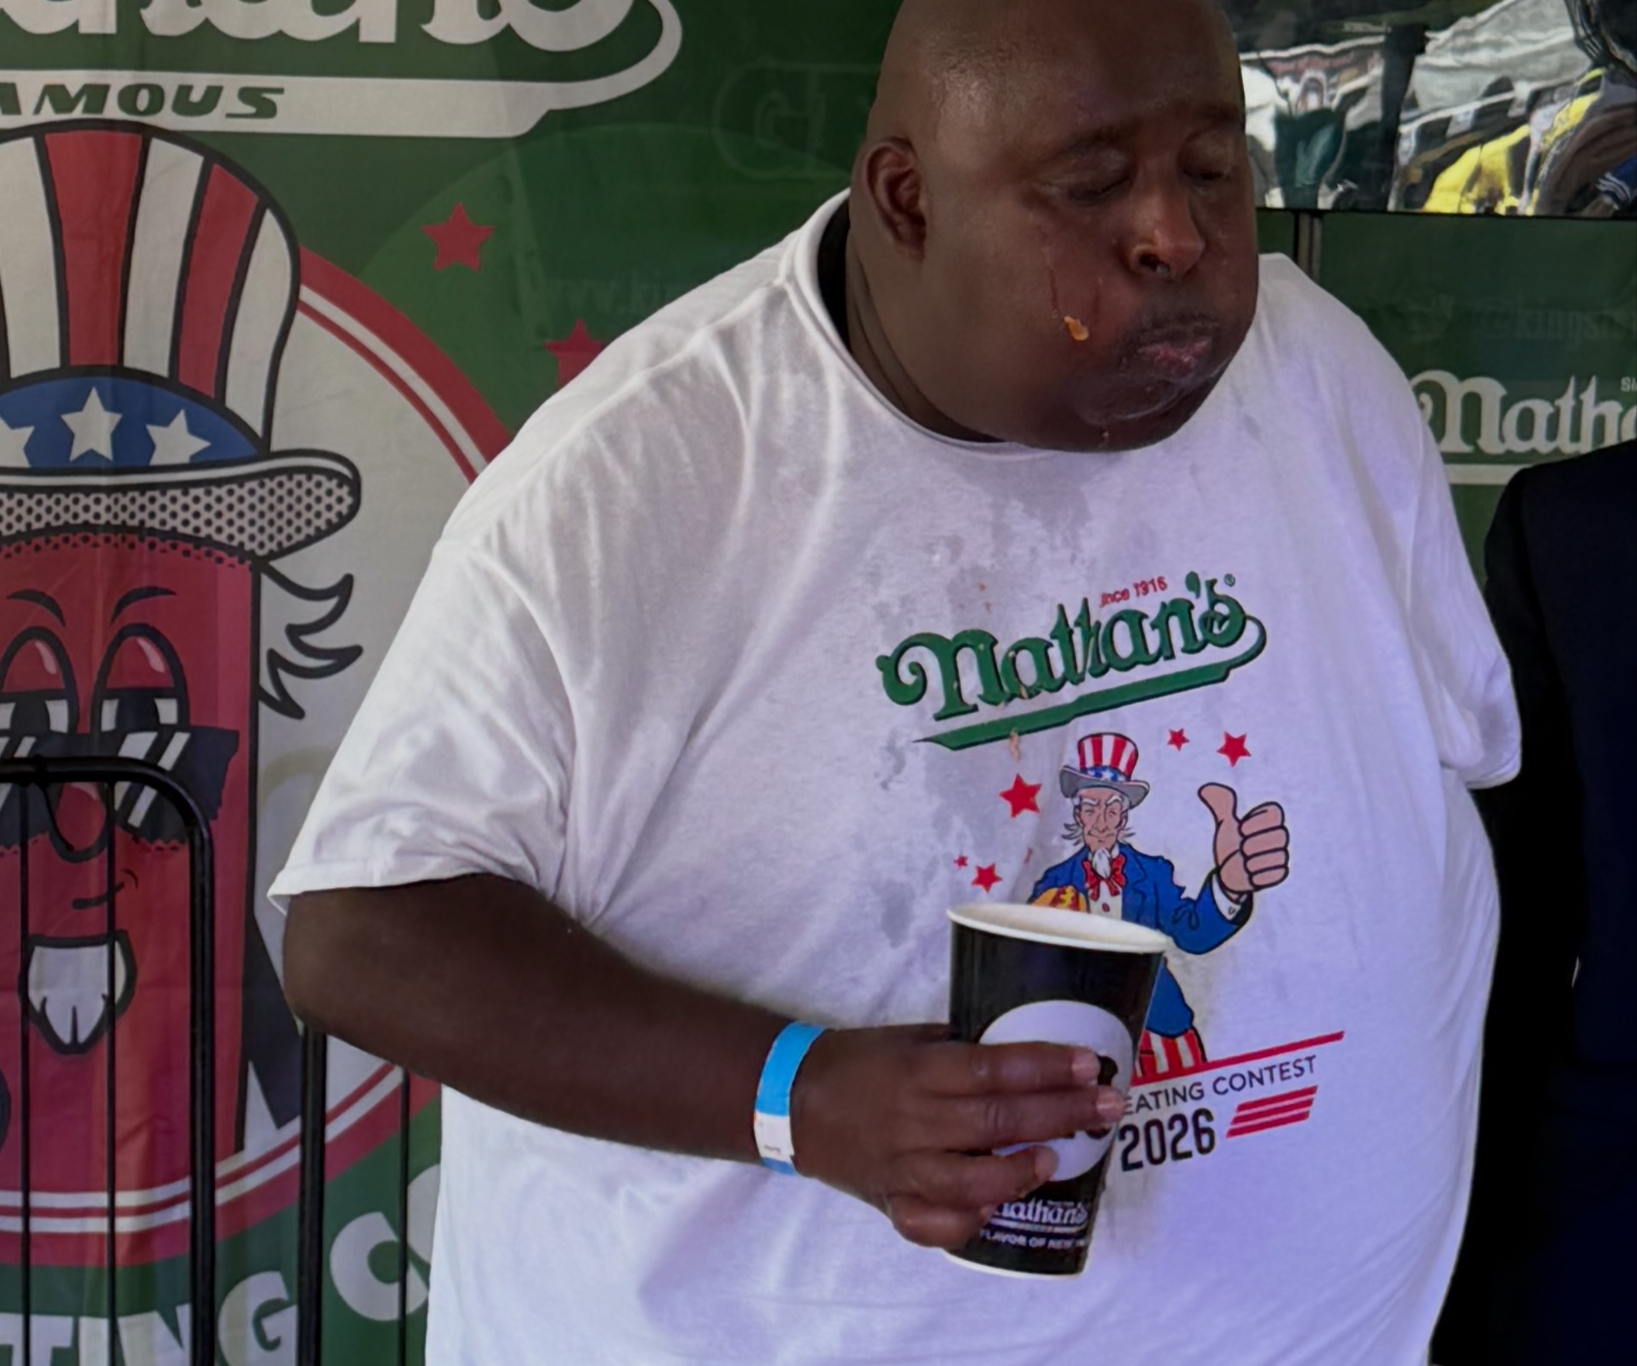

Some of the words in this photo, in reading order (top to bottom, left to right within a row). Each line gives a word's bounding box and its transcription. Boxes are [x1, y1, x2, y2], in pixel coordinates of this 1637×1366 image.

[1409, 370, 1637, 455] Nath
[1133, 576, 1169, 597] 1916
[1212, 1055, 1317, 1096] CONTEST
[1118, 1107, 1216, 1173] 2026
